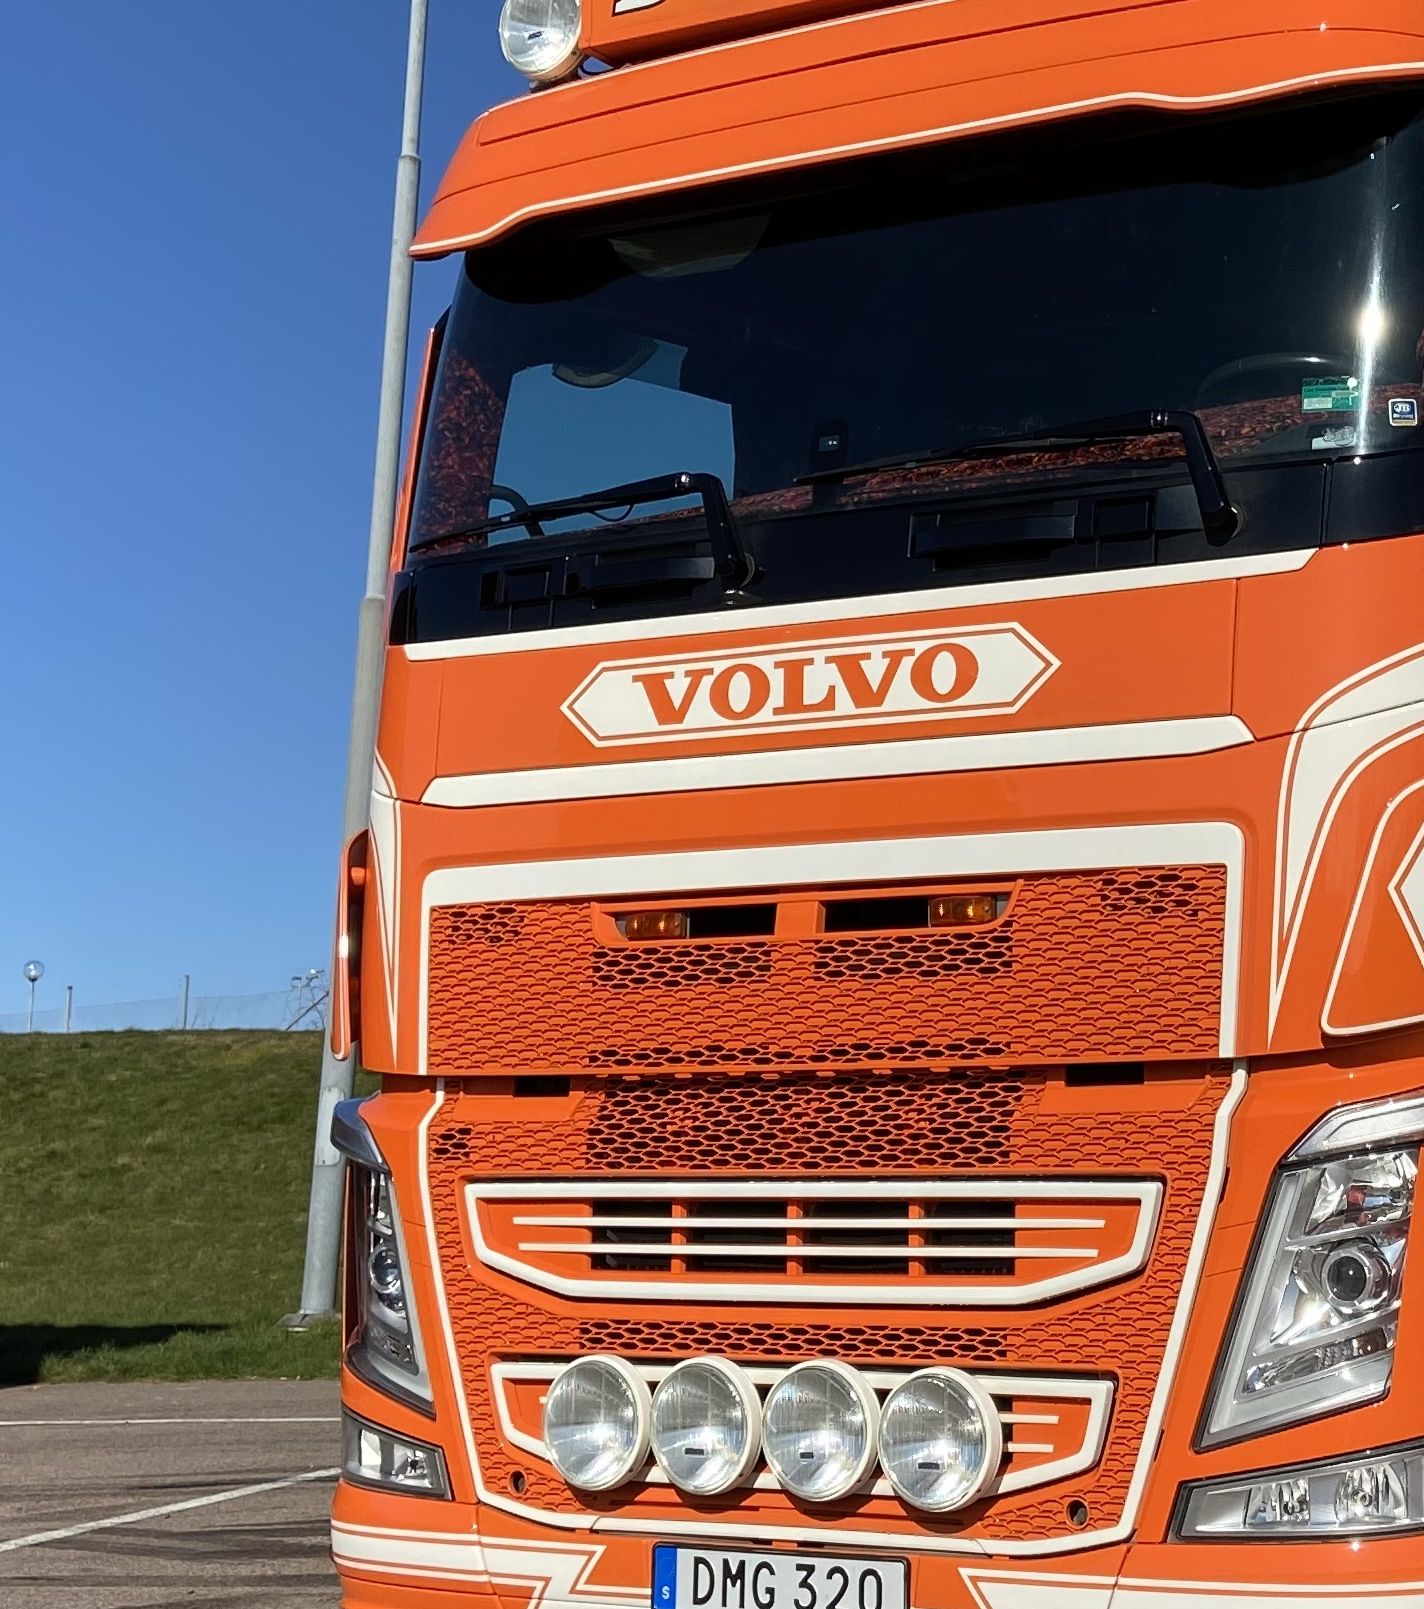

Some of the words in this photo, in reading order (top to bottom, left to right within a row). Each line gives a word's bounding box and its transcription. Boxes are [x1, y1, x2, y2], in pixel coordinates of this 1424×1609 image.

[631, 642, 980, 727] VOLVO
[661, 1585, 670, 1600] S
[692, 1556, 776, 1609] DMG
[793, 1563, 883, 1609] 320
